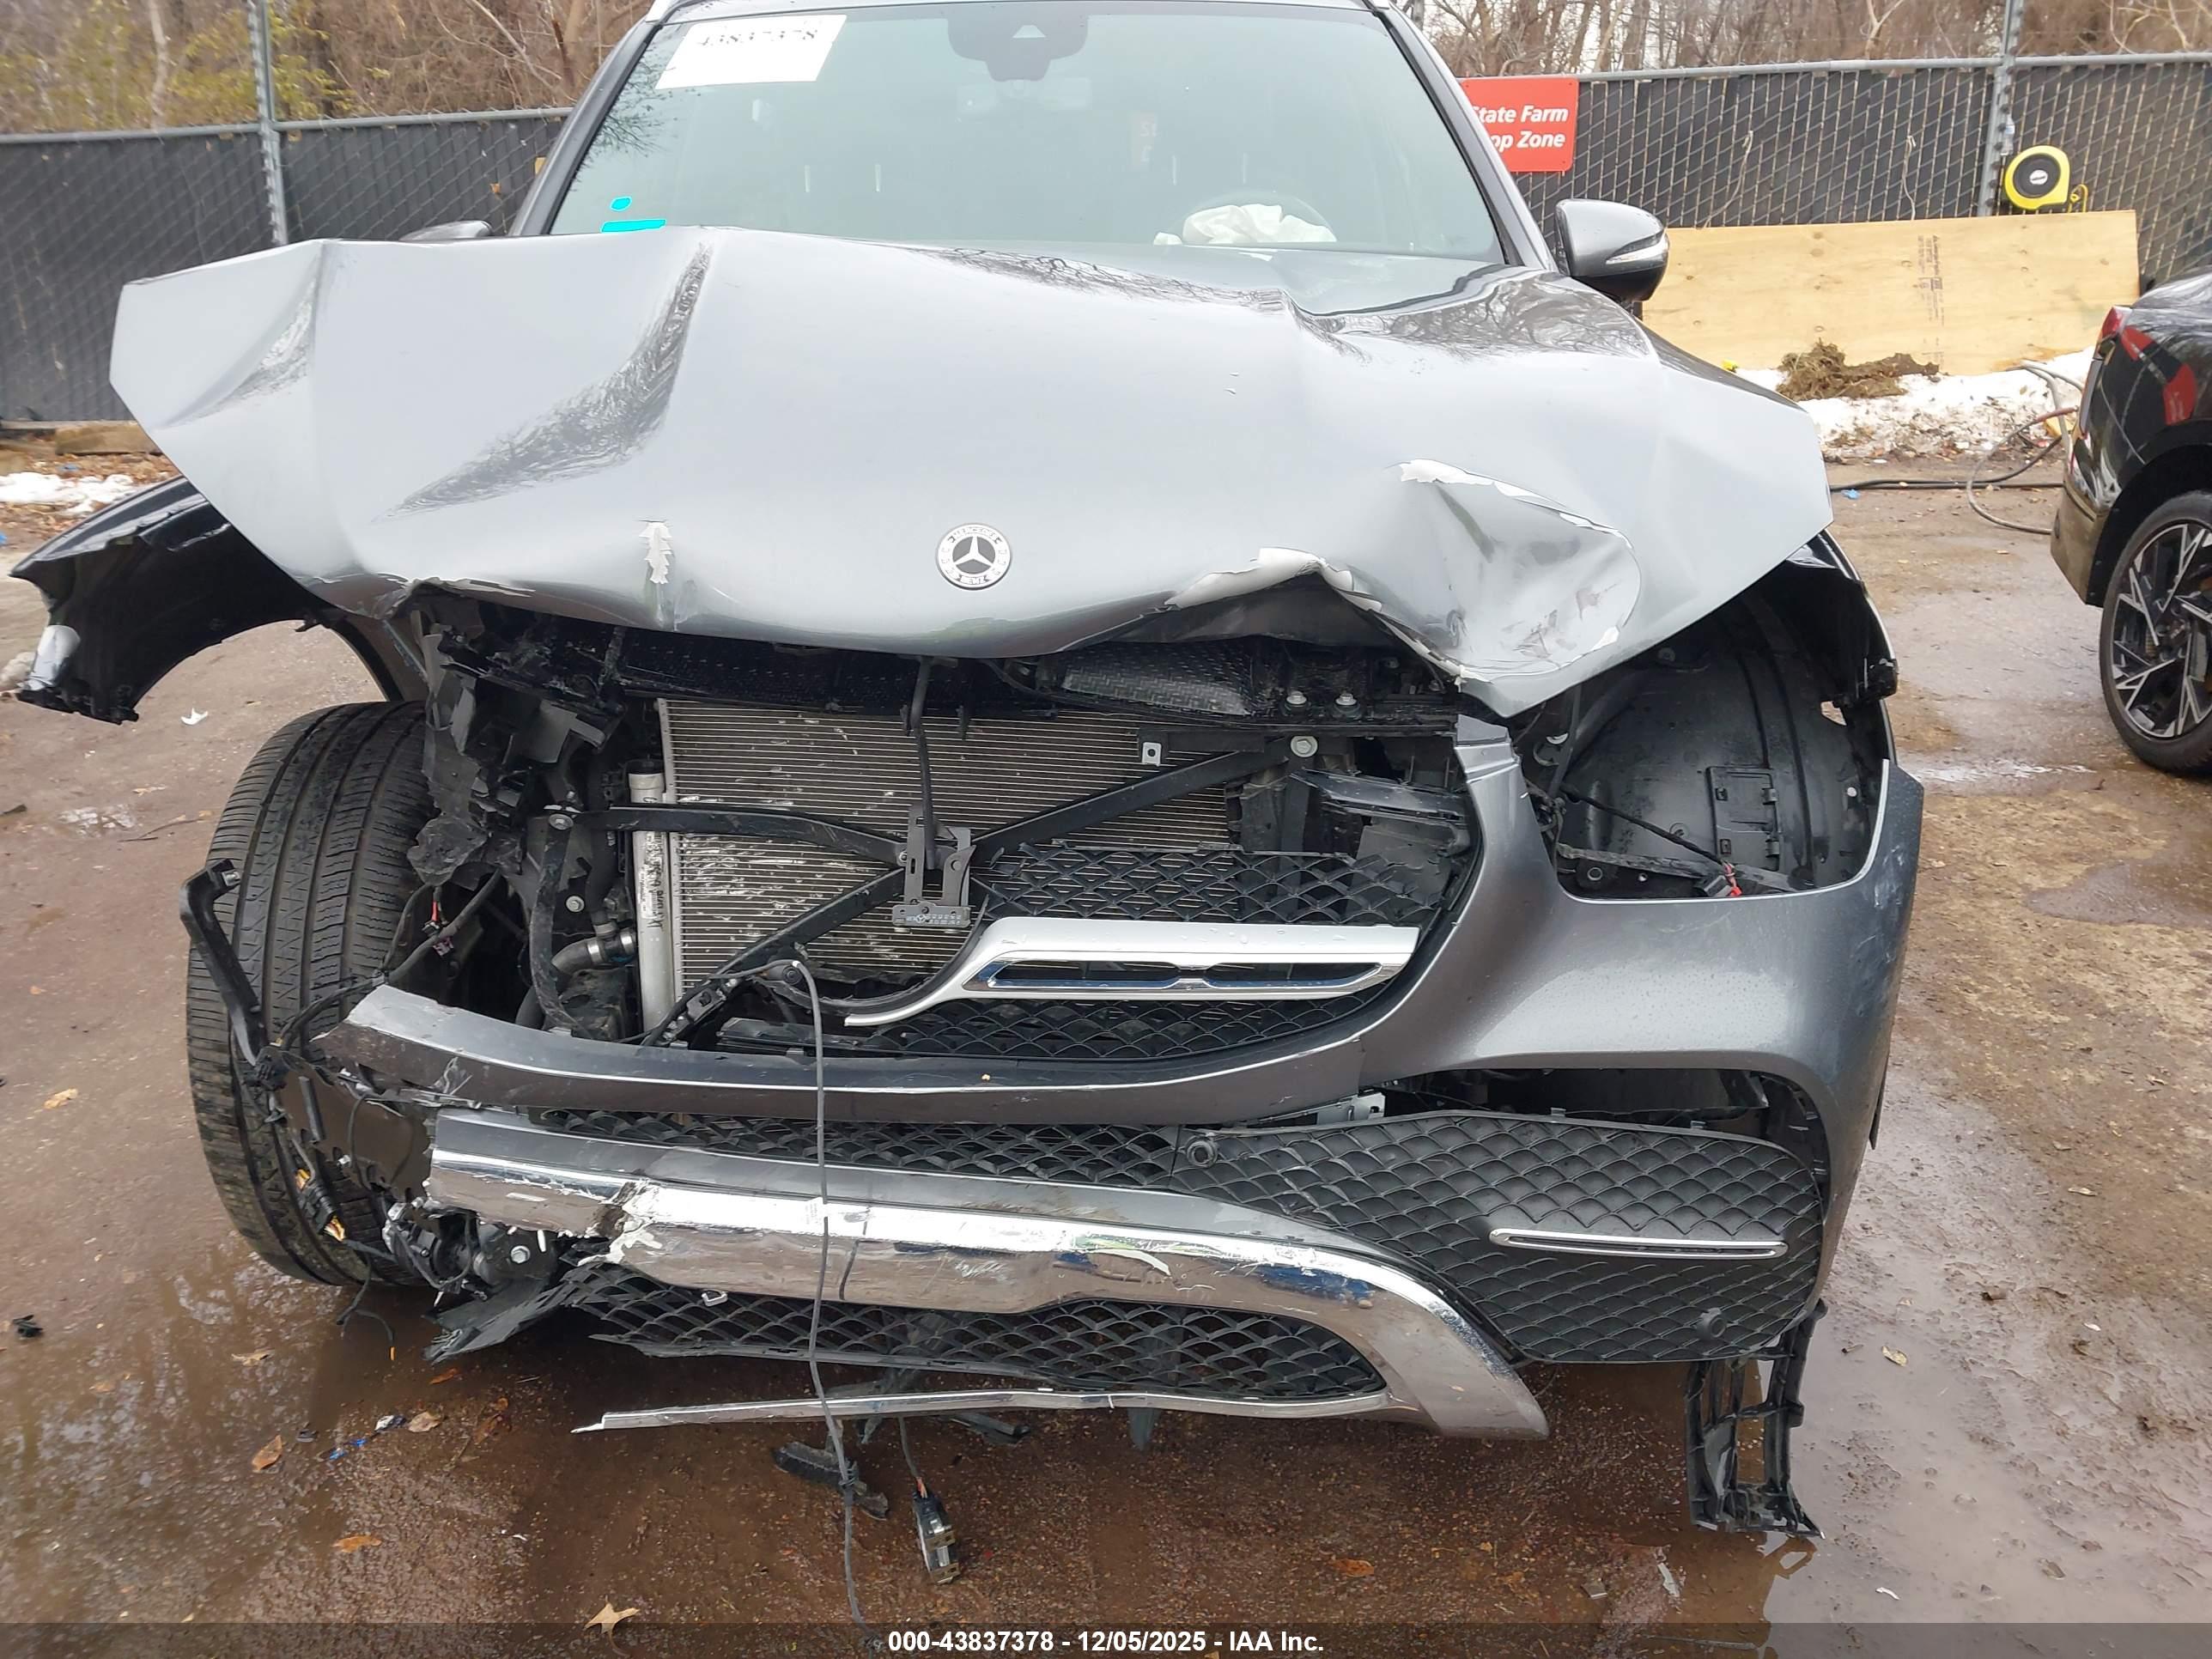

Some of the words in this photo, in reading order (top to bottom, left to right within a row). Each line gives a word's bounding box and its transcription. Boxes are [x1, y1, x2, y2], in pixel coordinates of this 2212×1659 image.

[1520, 104, 1570, 123] Farm
[1490, 134, 1514, 154] op
[1516, 130, 1567, 149] Zone
